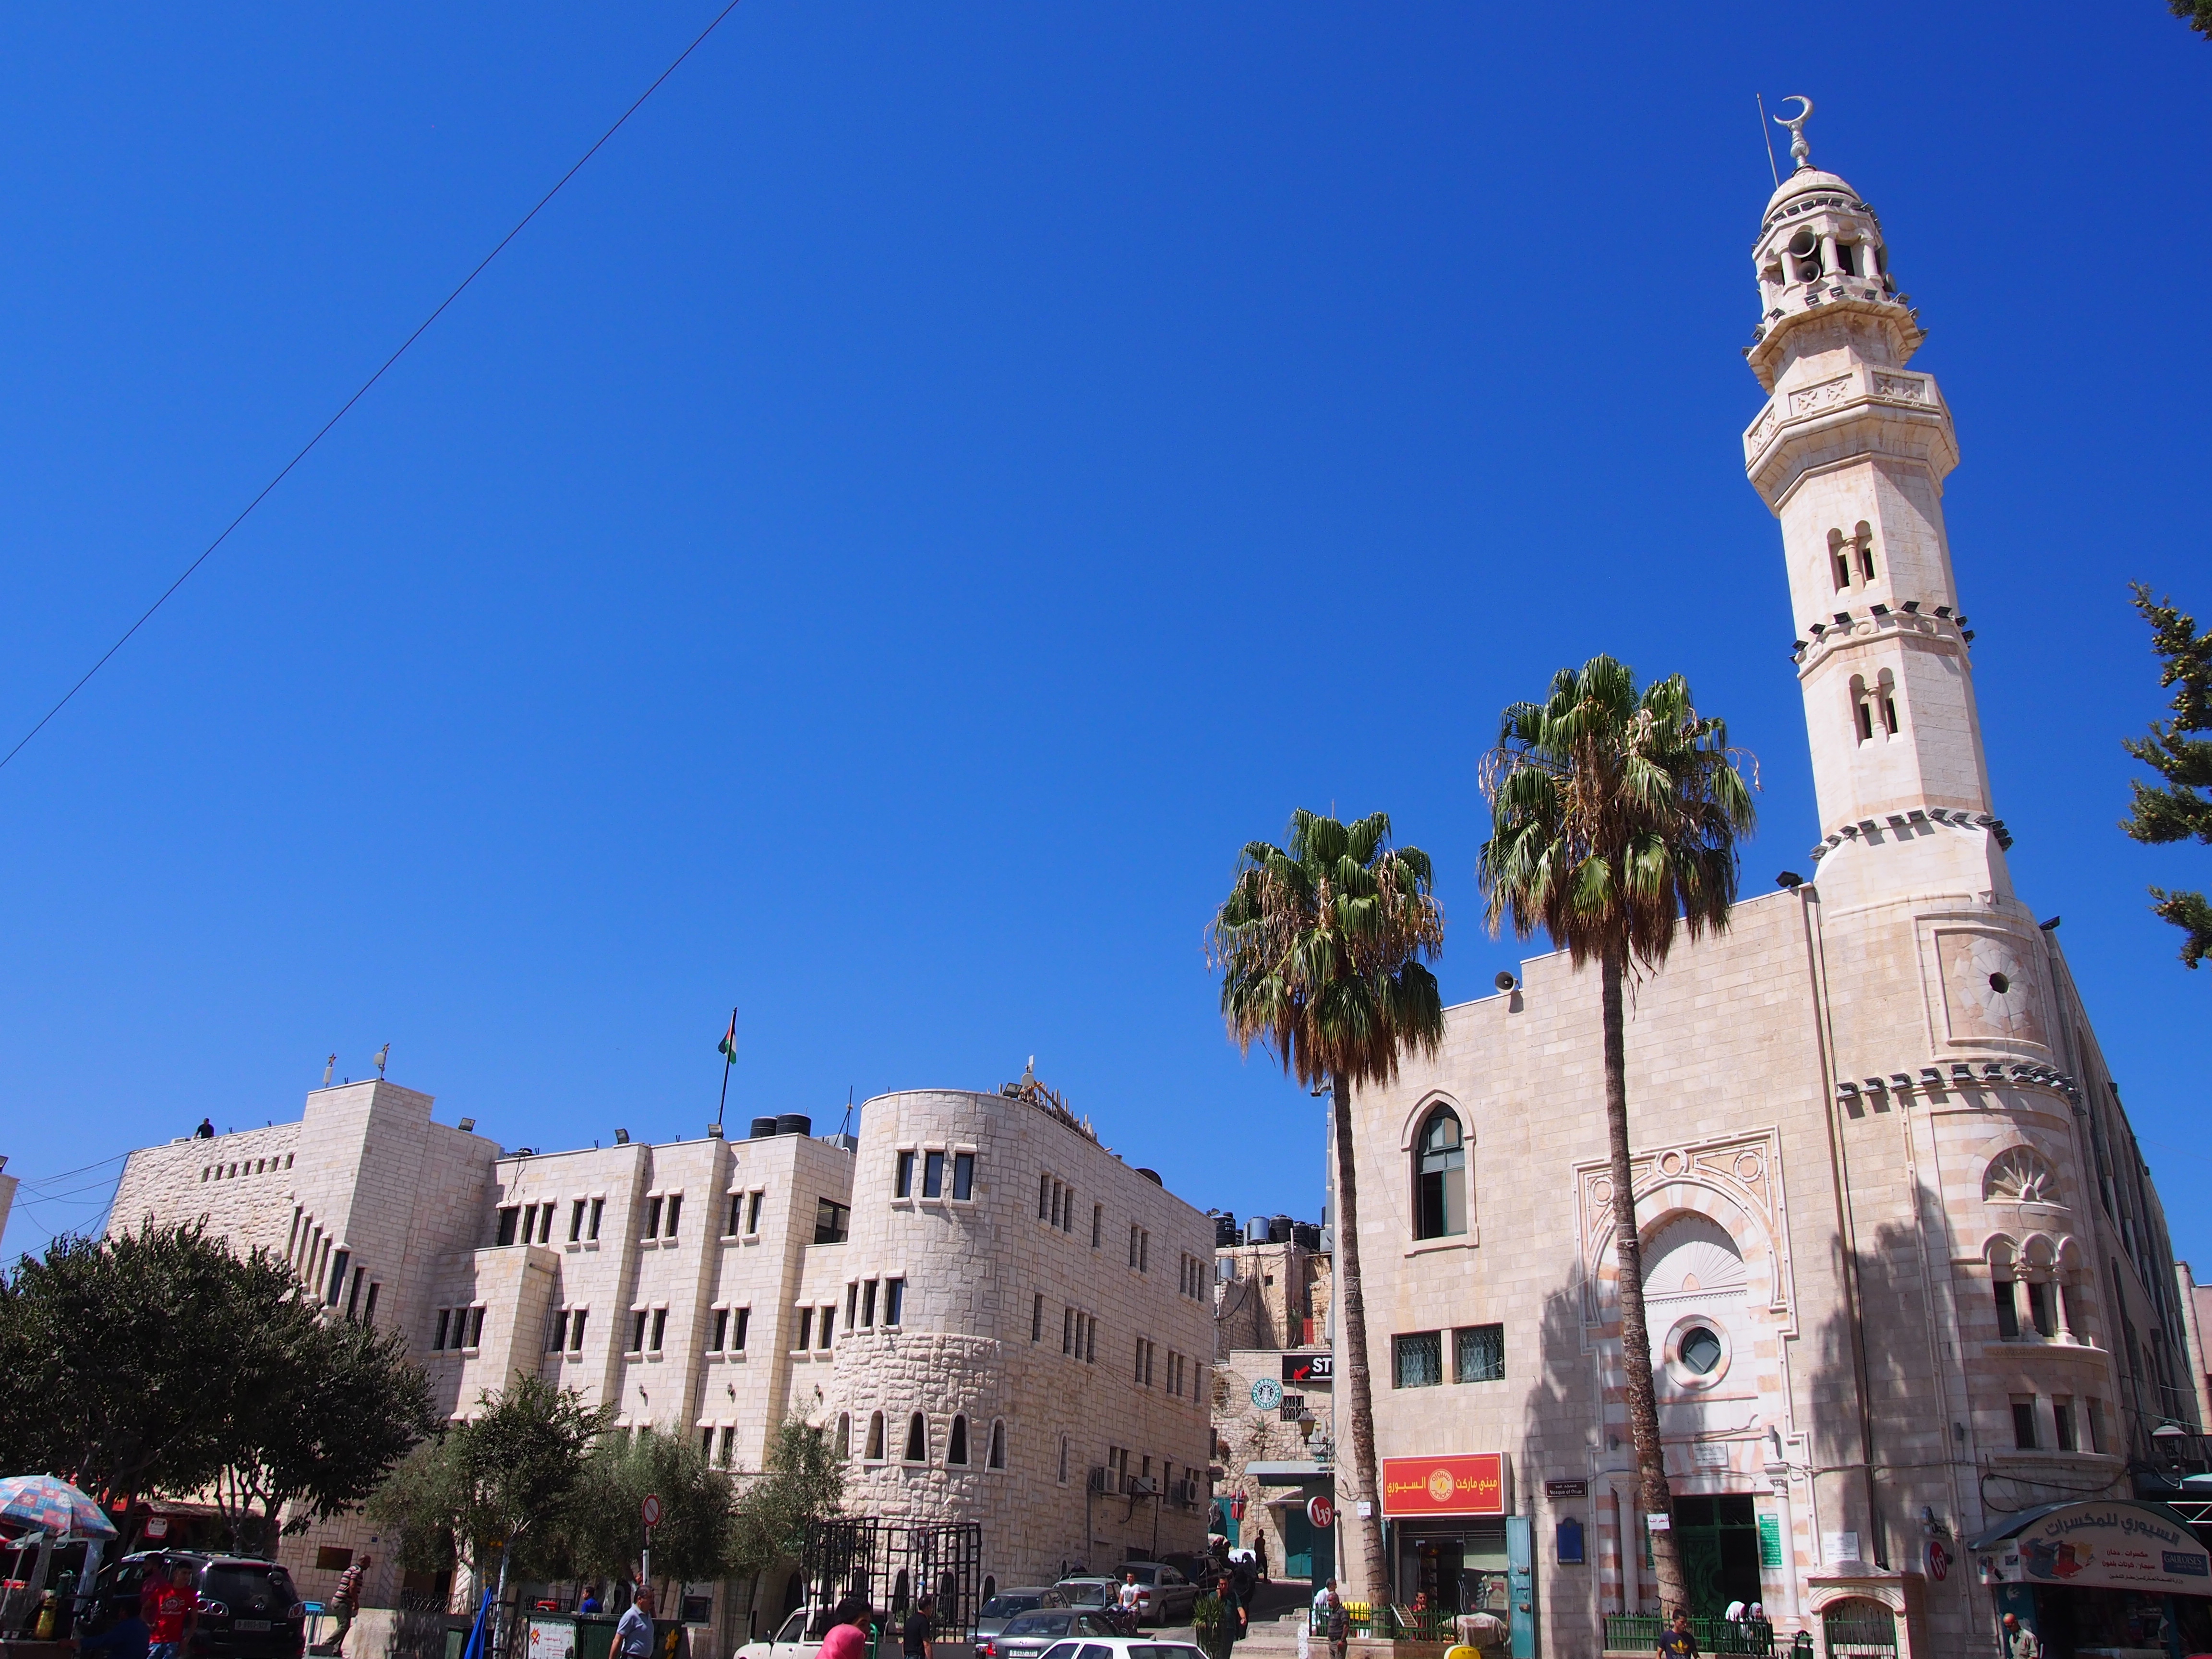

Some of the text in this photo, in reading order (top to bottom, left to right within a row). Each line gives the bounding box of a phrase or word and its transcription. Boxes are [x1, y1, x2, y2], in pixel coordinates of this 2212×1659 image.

[1312, 1358, 1332, 1373] ST
[1253, 1379, 1280, 1394] STARBUCKS
[1253, 1396, 1278, 1408] BETHLEHEM
[1387, 1476, 1497, 1497] ميني ماركت السيوري
[2045, 1512, 2180, 1547] السيوري للمكسرات
[2125, 1550, 2148, 1558] مكسرات
[2164, 1554, 2201, 1565] GAULOISES
